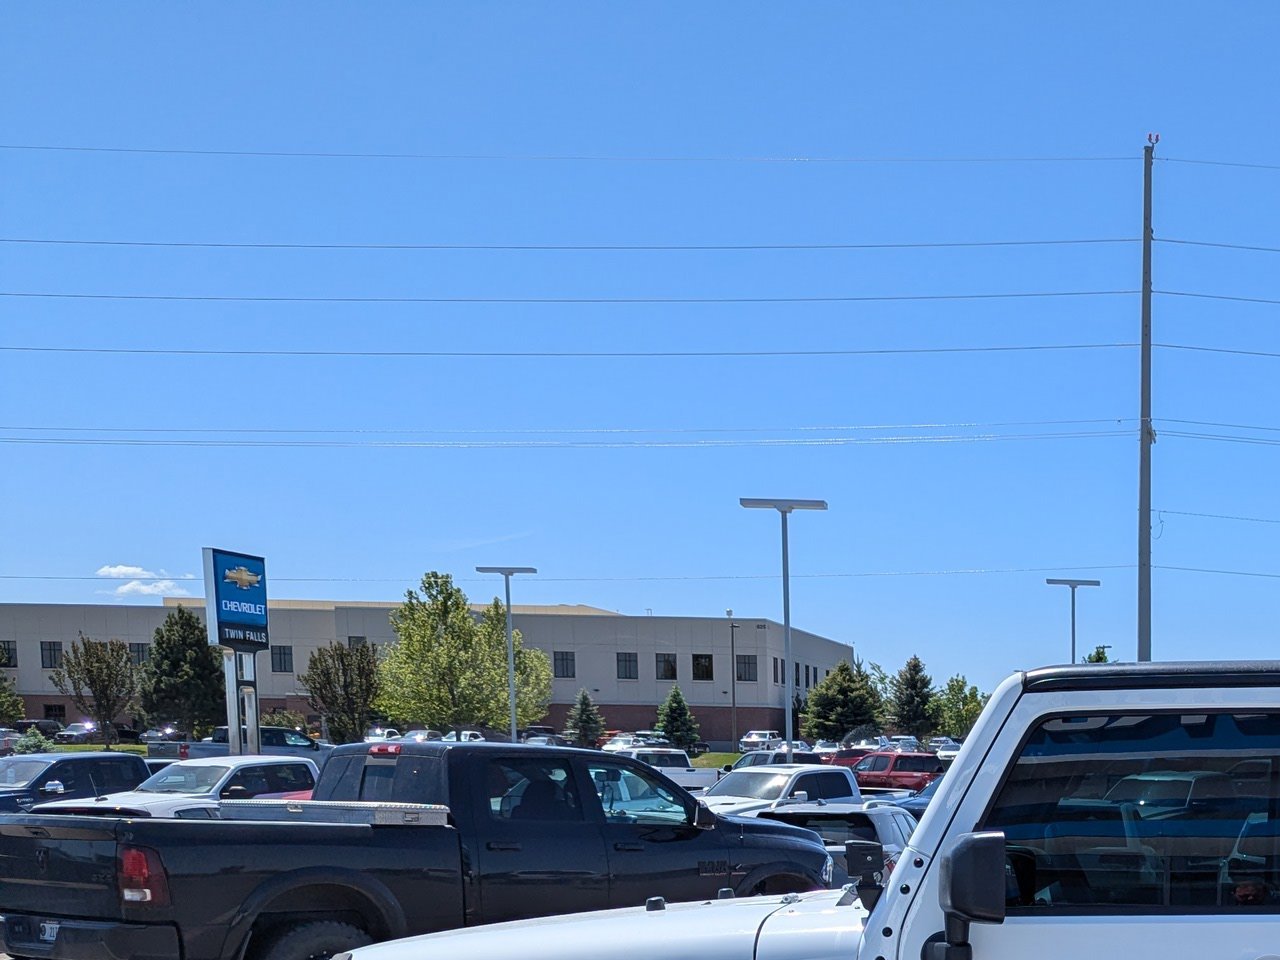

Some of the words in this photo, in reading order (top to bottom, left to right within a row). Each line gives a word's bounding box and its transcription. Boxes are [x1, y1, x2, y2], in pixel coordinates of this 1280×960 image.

[222, 600, 265, 615] CHEVROLET
[224, 628, 244, 640] TWIN
[245, 631, 267, 643] FALLS
